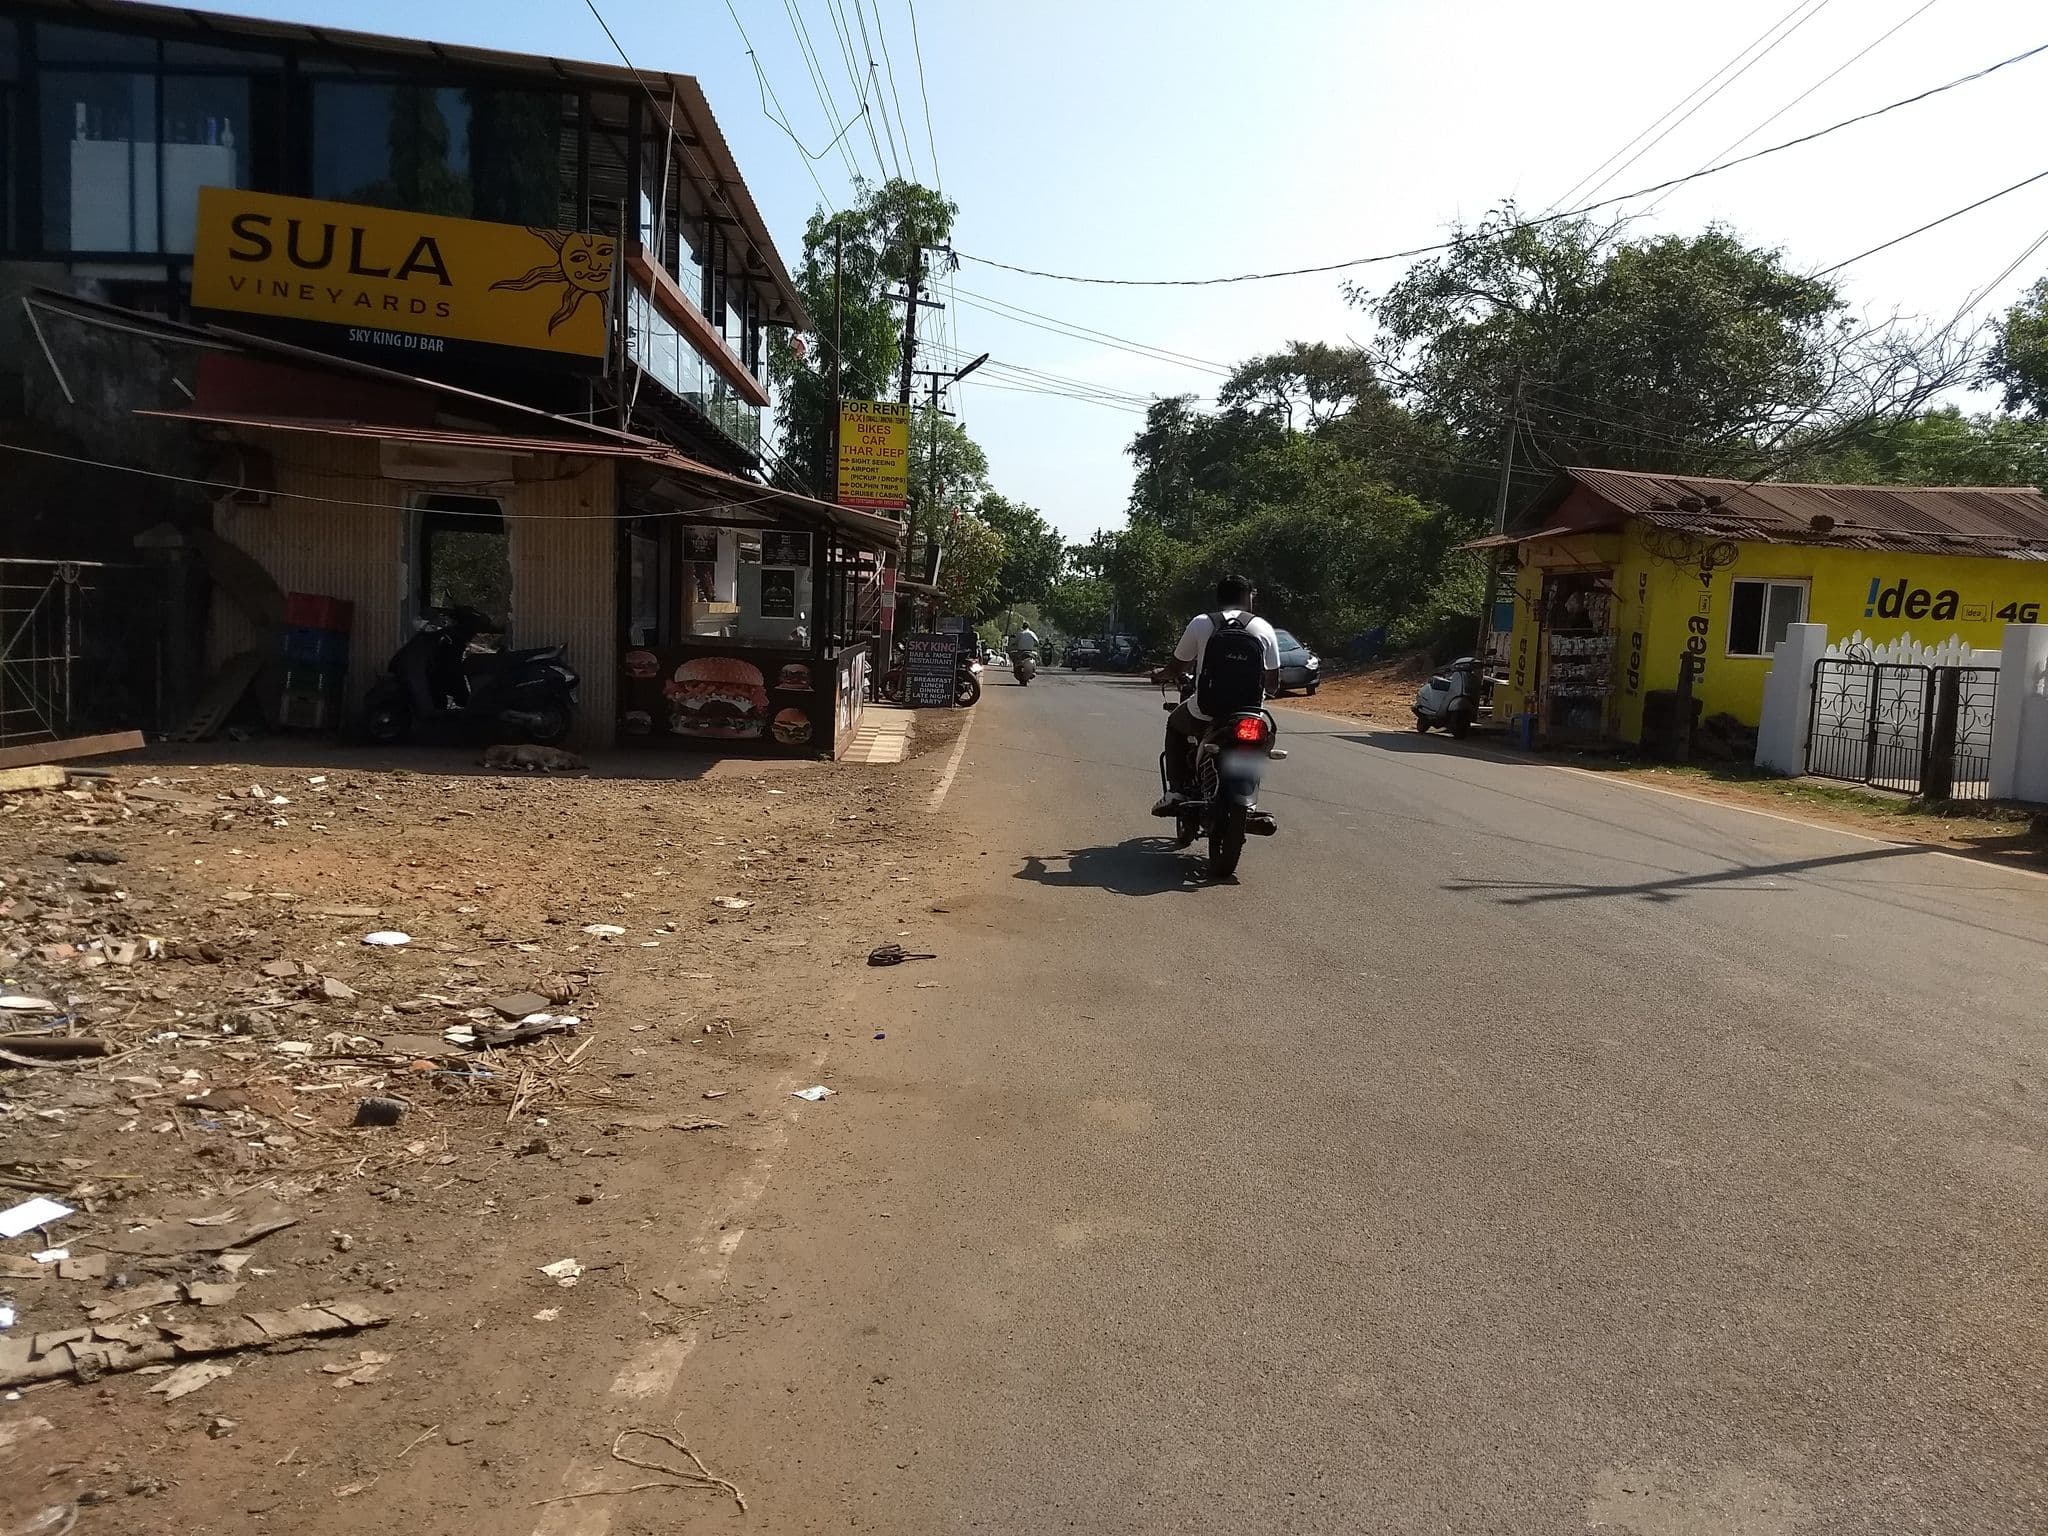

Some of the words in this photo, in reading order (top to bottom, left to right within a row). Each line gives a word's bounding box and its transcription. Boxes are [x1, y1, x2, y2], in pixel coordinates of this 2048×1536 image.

[228, 213, 453, 287] SULA
[228, 275, 452, 318] VINEYARDS
[349, 328, 369, 345] SKY
[370, 330, 401, 348] KING
[401, 334, 418, 350] DJ
[419, 336, 444, 353] BAR
[841, 401, 869, 414] FOR
[873, 403, 908, 416] RENT
[842, 413, 865, 423] TAXI
[857, 423, 891, 435] BIKES
[862, 435, 886, 446] CAR
[842, 445, 873, 457] THAR
[876, 448, 905, 458] JEEP
[1996, 602, 2041, 624] 4G
[908, 640, 929, 651] SKY
[930, 642, 956, 653] KING
[913, 676, 952, 684] BREAKFAST
